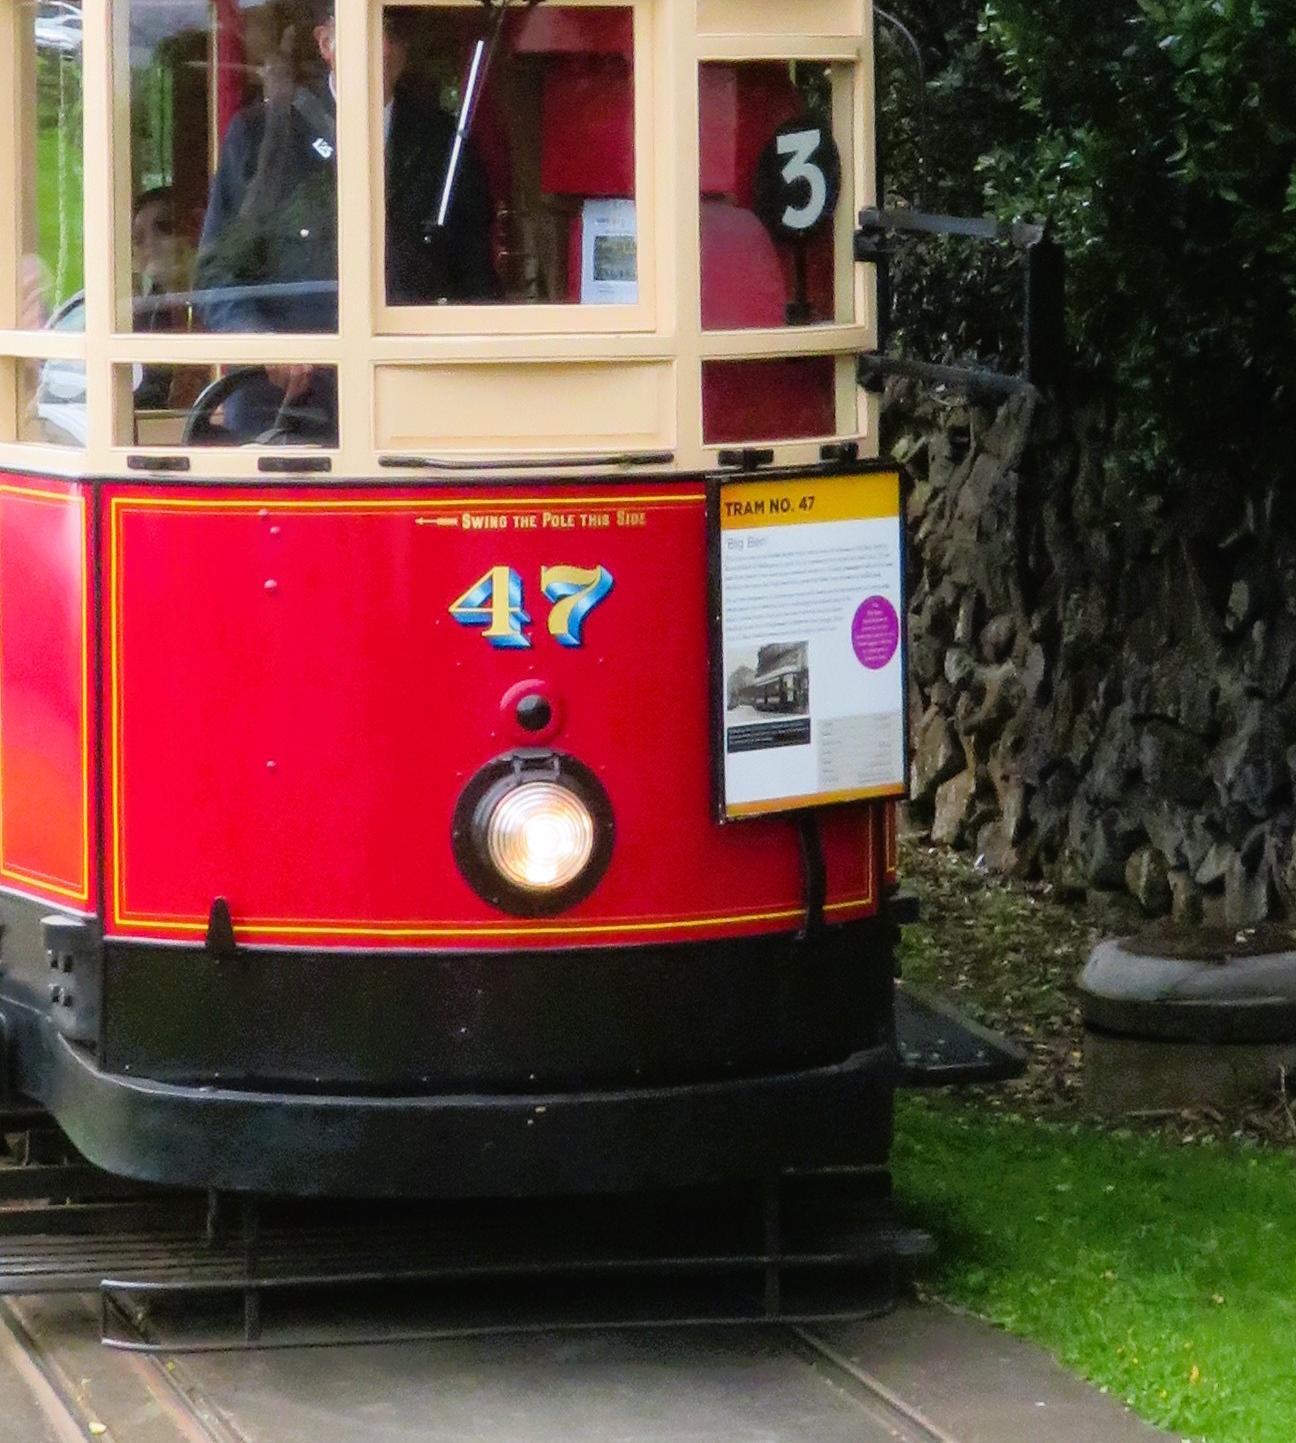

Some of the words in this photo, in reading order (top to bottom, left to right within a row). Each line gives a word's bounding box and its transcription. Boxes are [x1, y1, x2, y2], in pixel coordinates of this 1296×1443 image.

[776, 129, 827, 229] 3
[462, 512, 508, 530] SWING
[513, 514, 537, 528] THE
[542, 512, 575, 529] POLE
[724, 500, 765, 518] TRAM
[769, 497, 795, 514] NO.
[798, 495, 815, 511] 47
[448, 564, 614, 650] 47
